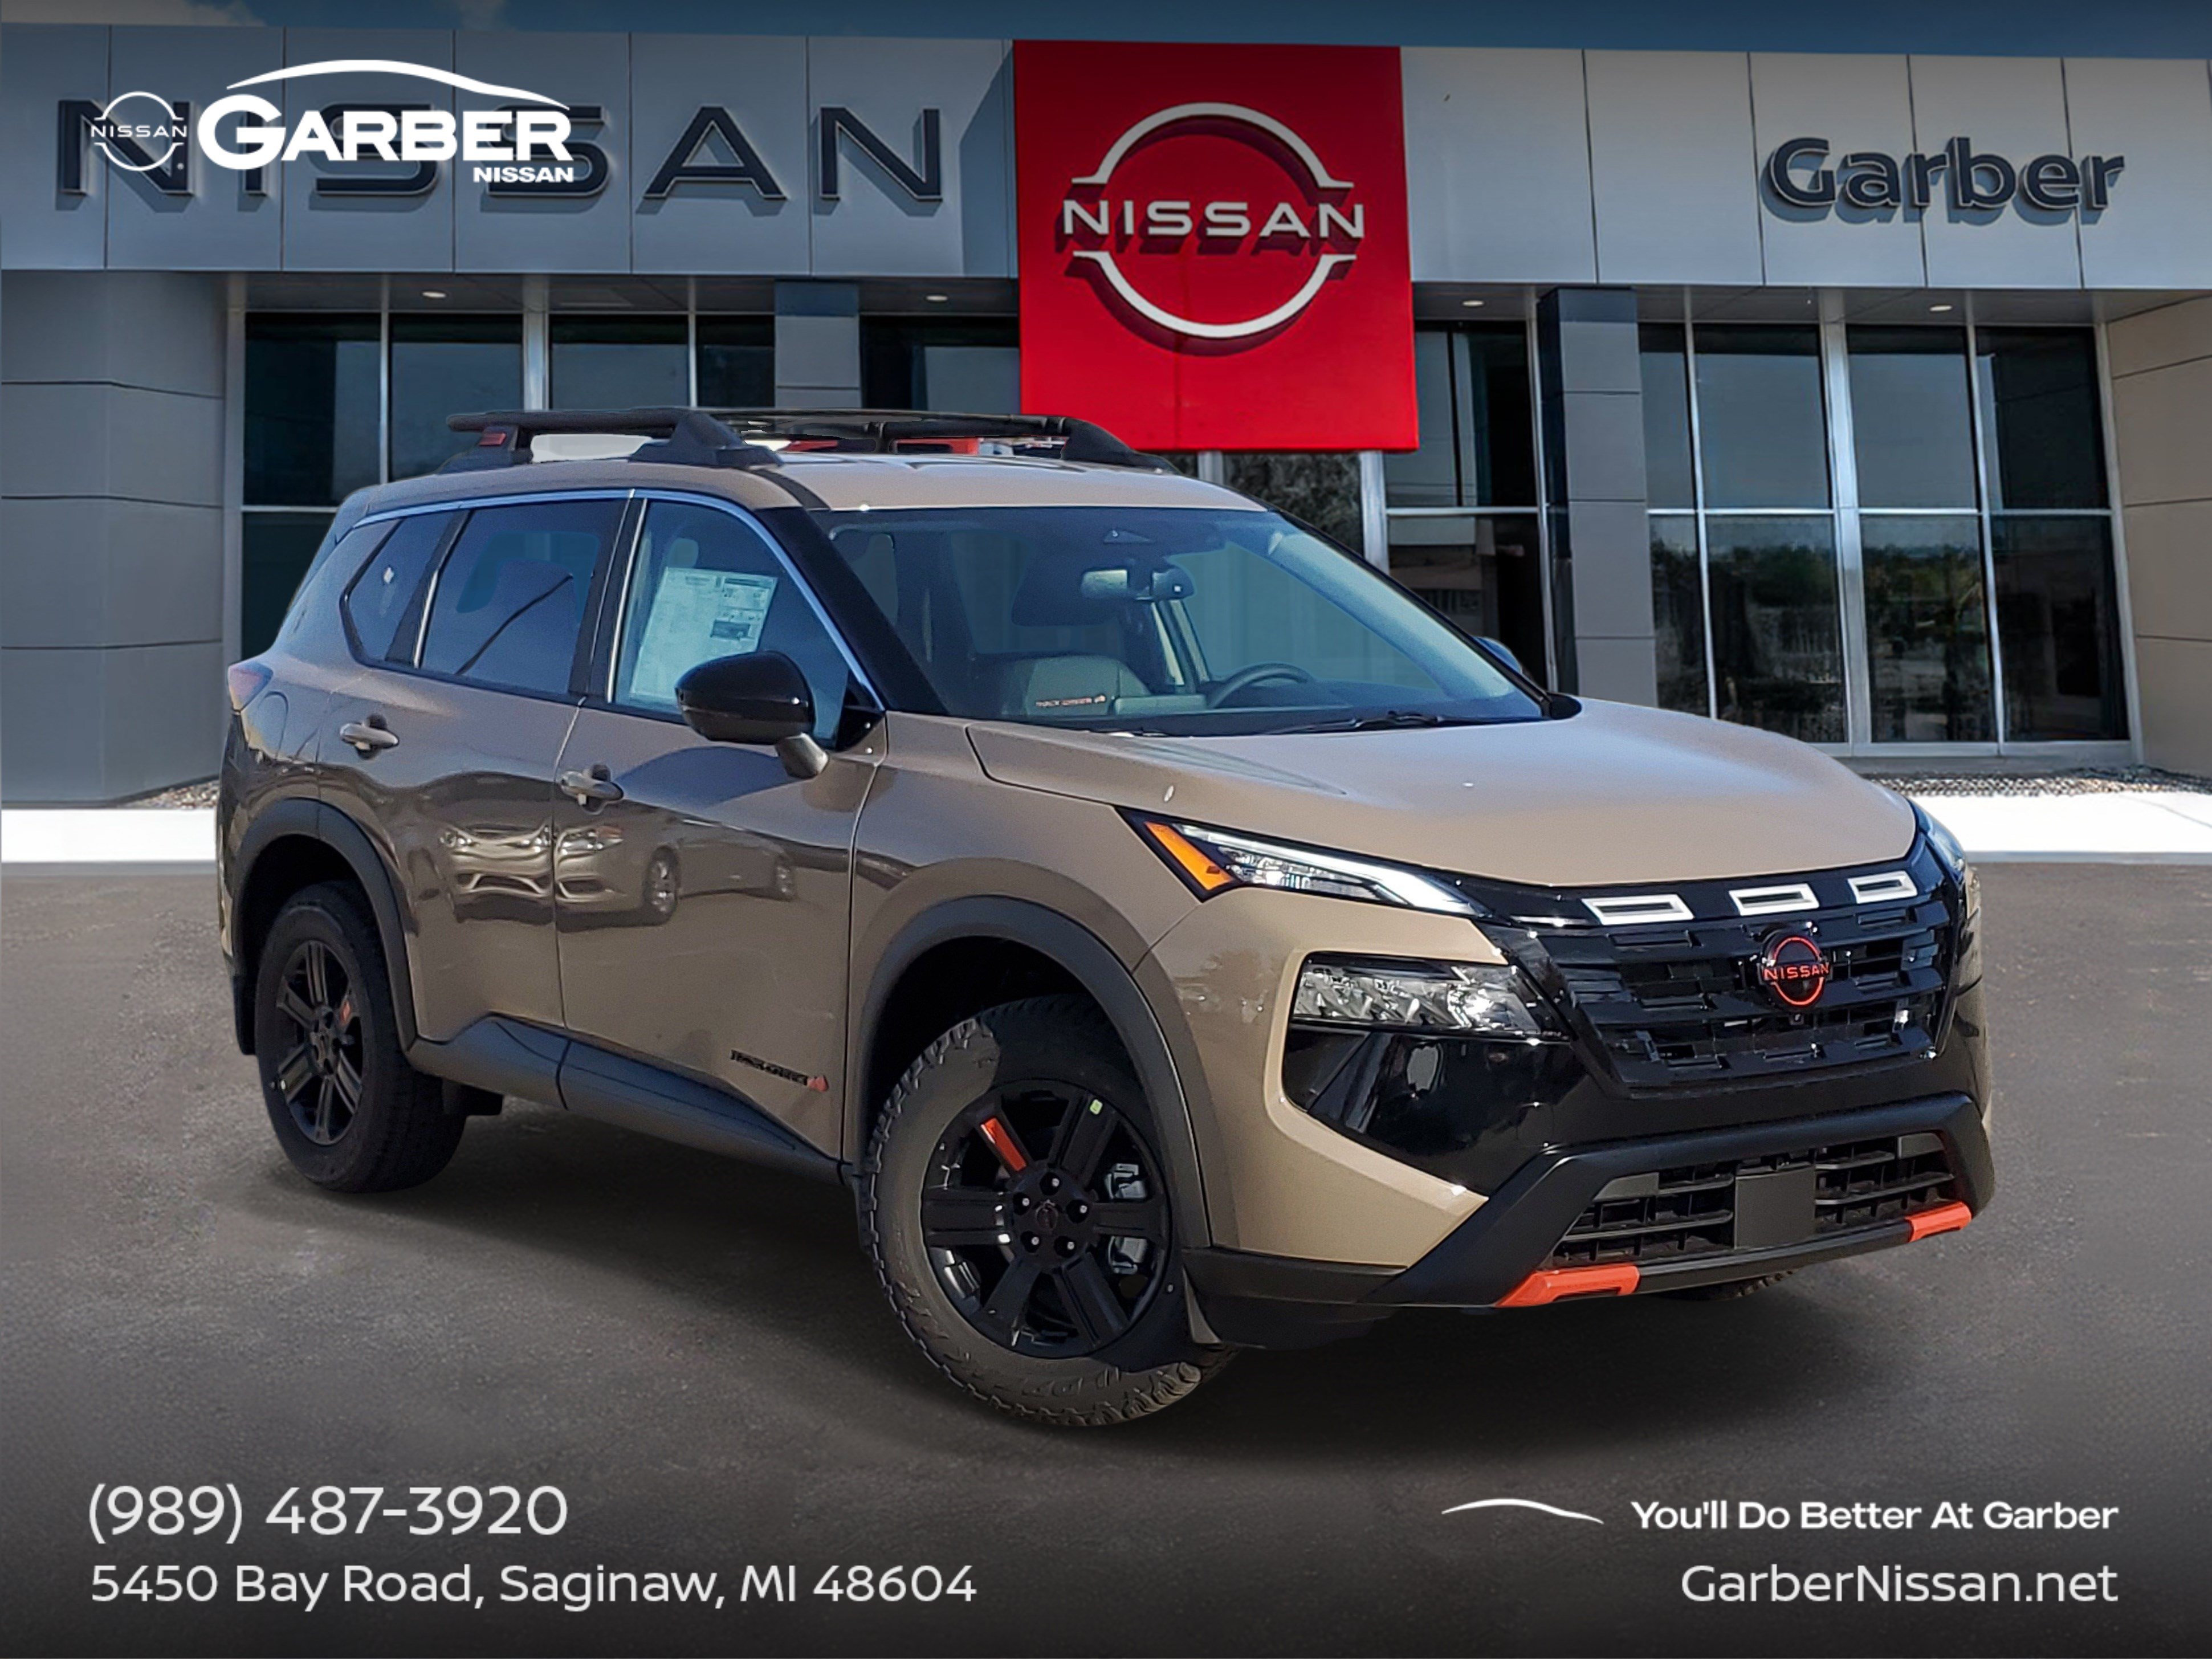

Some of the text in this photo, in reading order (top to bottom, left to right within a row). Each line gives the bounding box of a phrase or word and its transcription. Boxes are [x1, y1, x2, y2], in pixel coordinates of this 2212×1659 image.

[1768, 136, 2125, 210] Garber
[1063, 199, 1365, 238] NISSAN
[1763, 962, 1830, 980] NISSAN
